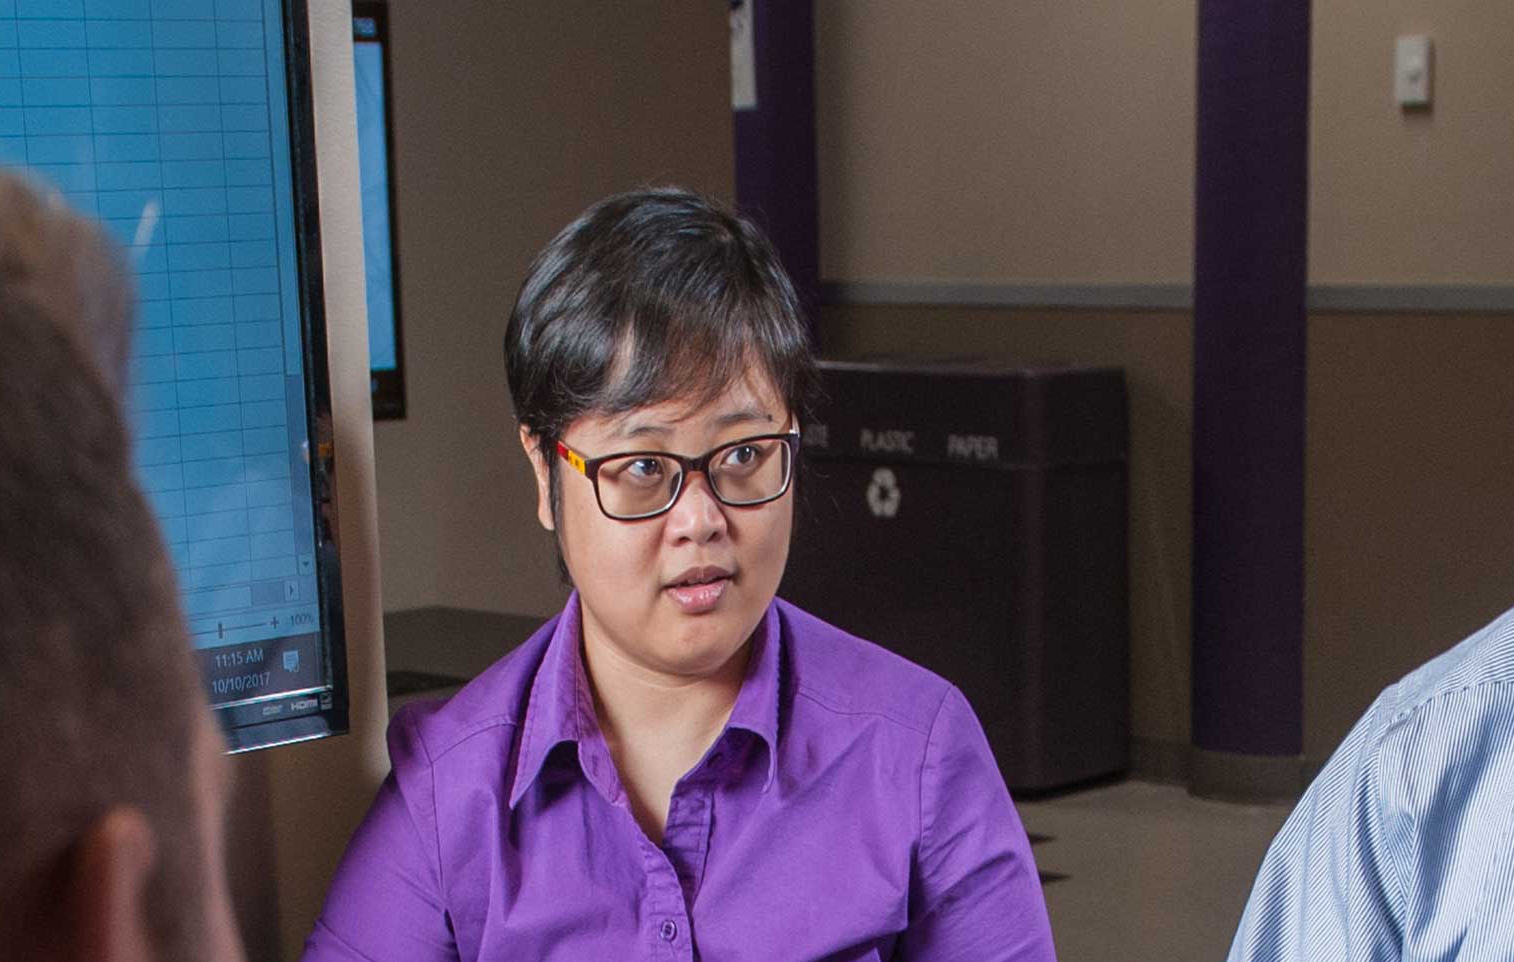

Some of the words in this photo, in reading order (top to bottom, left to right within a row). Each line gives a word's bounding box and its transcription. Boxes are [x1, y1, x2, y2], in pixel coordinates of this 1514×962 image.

[947, 433, 998, 460] PAPER
[215, 652, 243, 668] 11:15
[246, 649, 264, 664] AM
[212, 672, 271, 695] 10/10/2017
